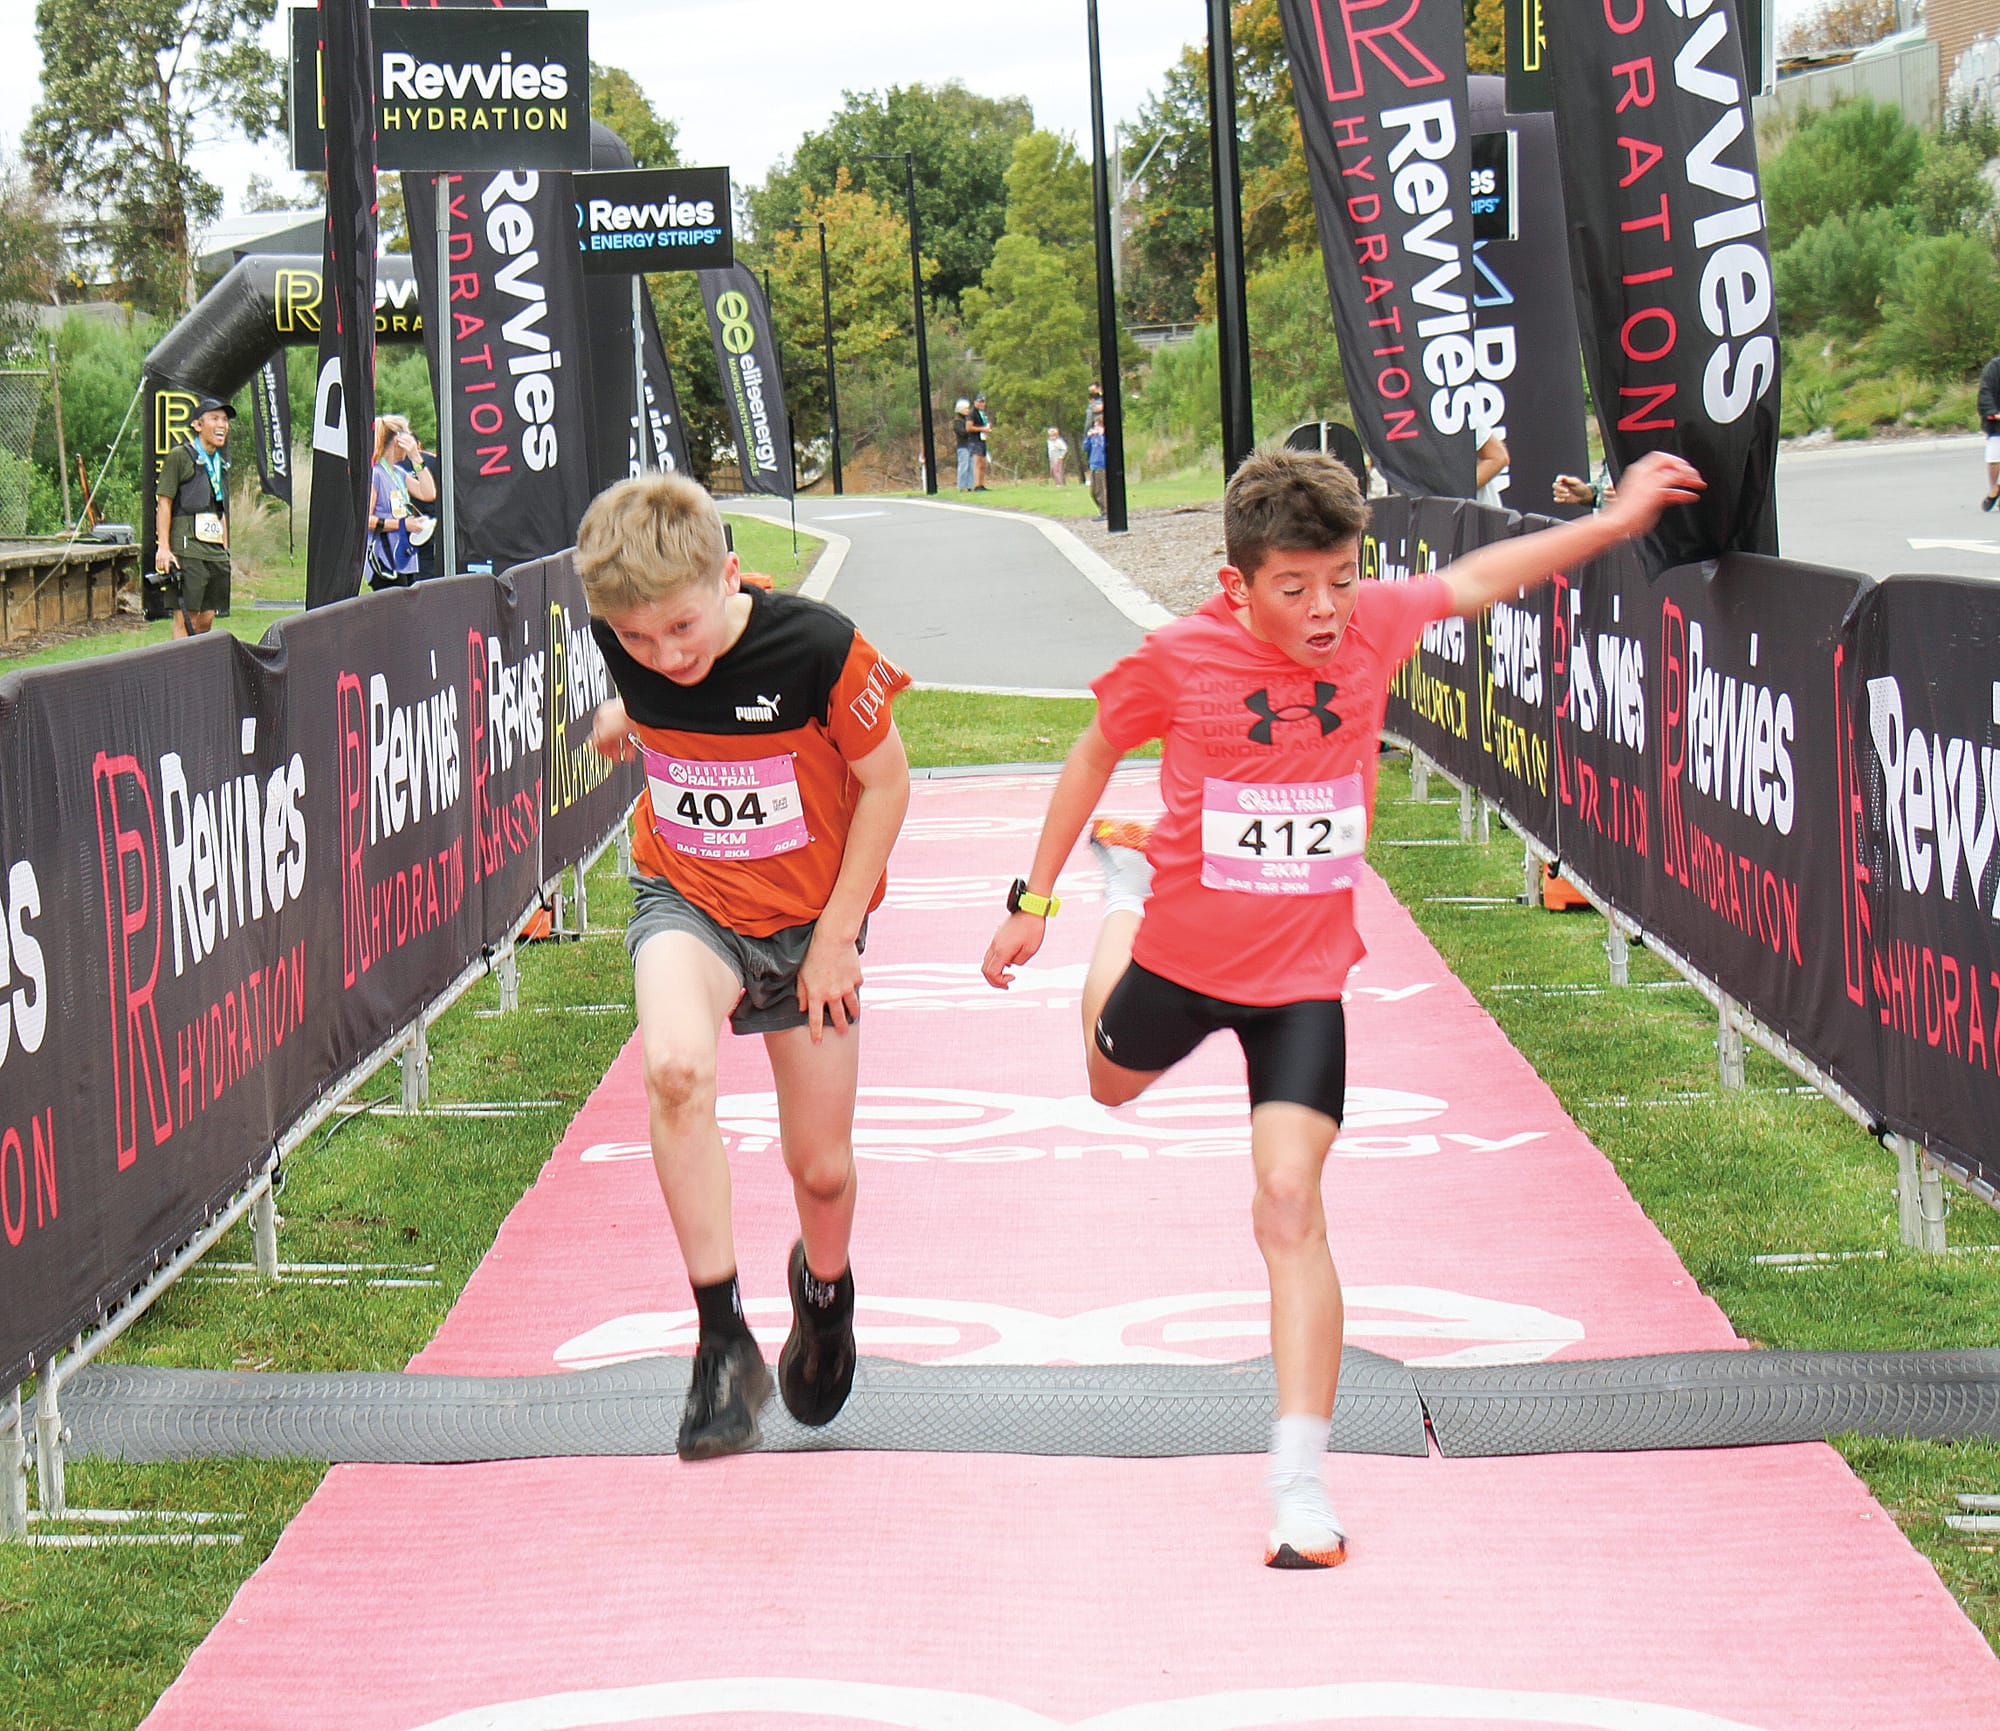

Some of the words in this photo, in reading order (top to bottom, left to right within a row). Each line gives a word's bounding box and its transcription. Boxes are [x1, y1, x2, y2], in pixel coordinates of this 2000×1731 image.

[382, 52, 568, 100] Revvies
[383, 107, 567, 130] HYDRATION
[589, 195, 715, 231] Revvies
[591, 232, 654, 250] ENERGY
[1333, 115, 1419, 441] HYDRATION
[1379, 99, 1477, 436] Revvies
[728, 357, 742, 393] MAKING
[735, 394, 748, 429] EVENTS
[735, 705, 773, 722] PUMA
[1687, 620, 1794, 836] Revvies
[369, 649, 462, 847] Revvies
[687, 774, 718, 786] RAIL
[721, 775, 760, 786] TRAIL
[676, 791, 767, 828] 404
[159, 717, 308, 978] Revvies
[700, 849, 721, 858] TAG
[724, 849, 750, 858] 2KM
[703, 832, 747, 845] 2KM
[1238, 817, 1333, 857] 412
[370, 834, 465, 963] HYDRATION
[1689, 820, 1802, 967] HYDRATION
[177, 938, 306, 1130] HYDRATION
